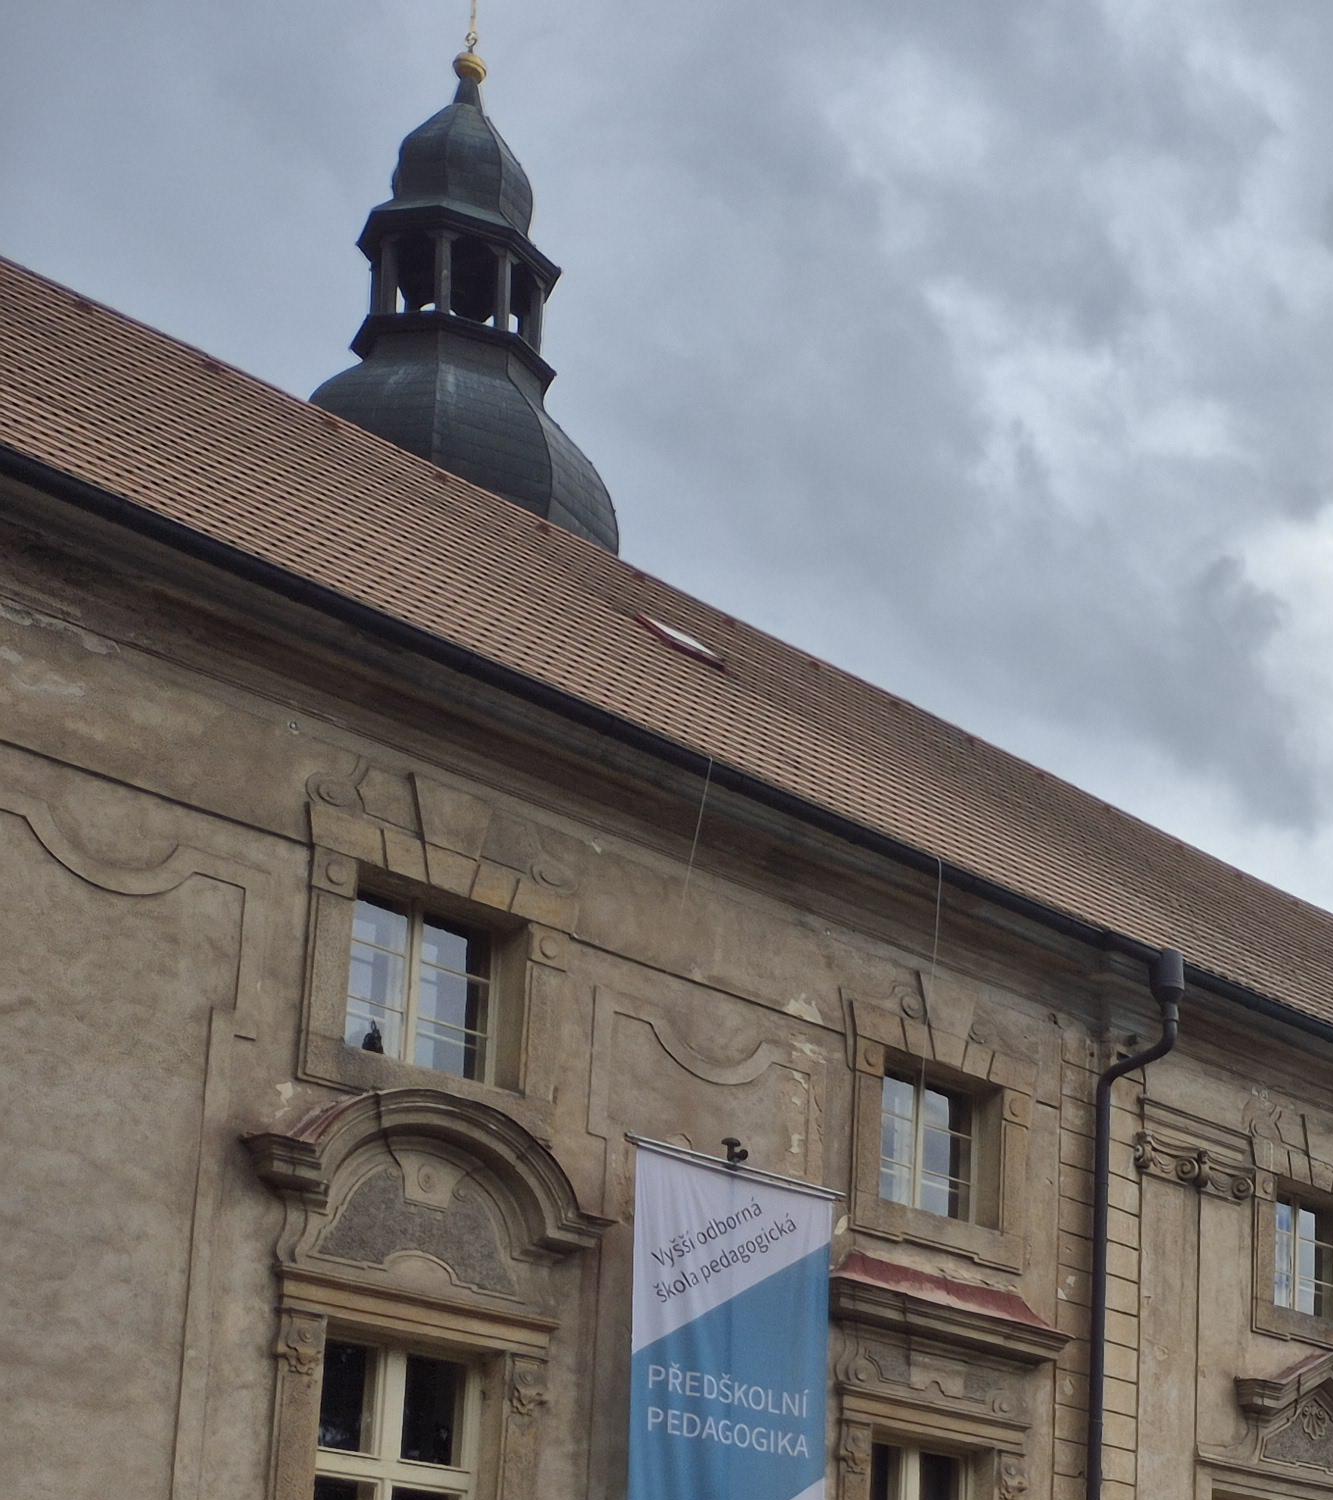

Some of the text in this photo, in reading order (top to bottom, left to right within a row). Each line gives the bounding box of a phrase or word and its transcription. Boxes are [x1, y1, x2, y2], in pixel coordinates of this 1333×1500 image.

[651, 1197, 762, 1268] Vyšší odborná
[652, 1212, 797, 1303] škola pedagogická
[647, 1361, 809, 1419] PŘEDŠKOLNÍ
[647, 1406, 809, 1458] PEDAGOGIKA
